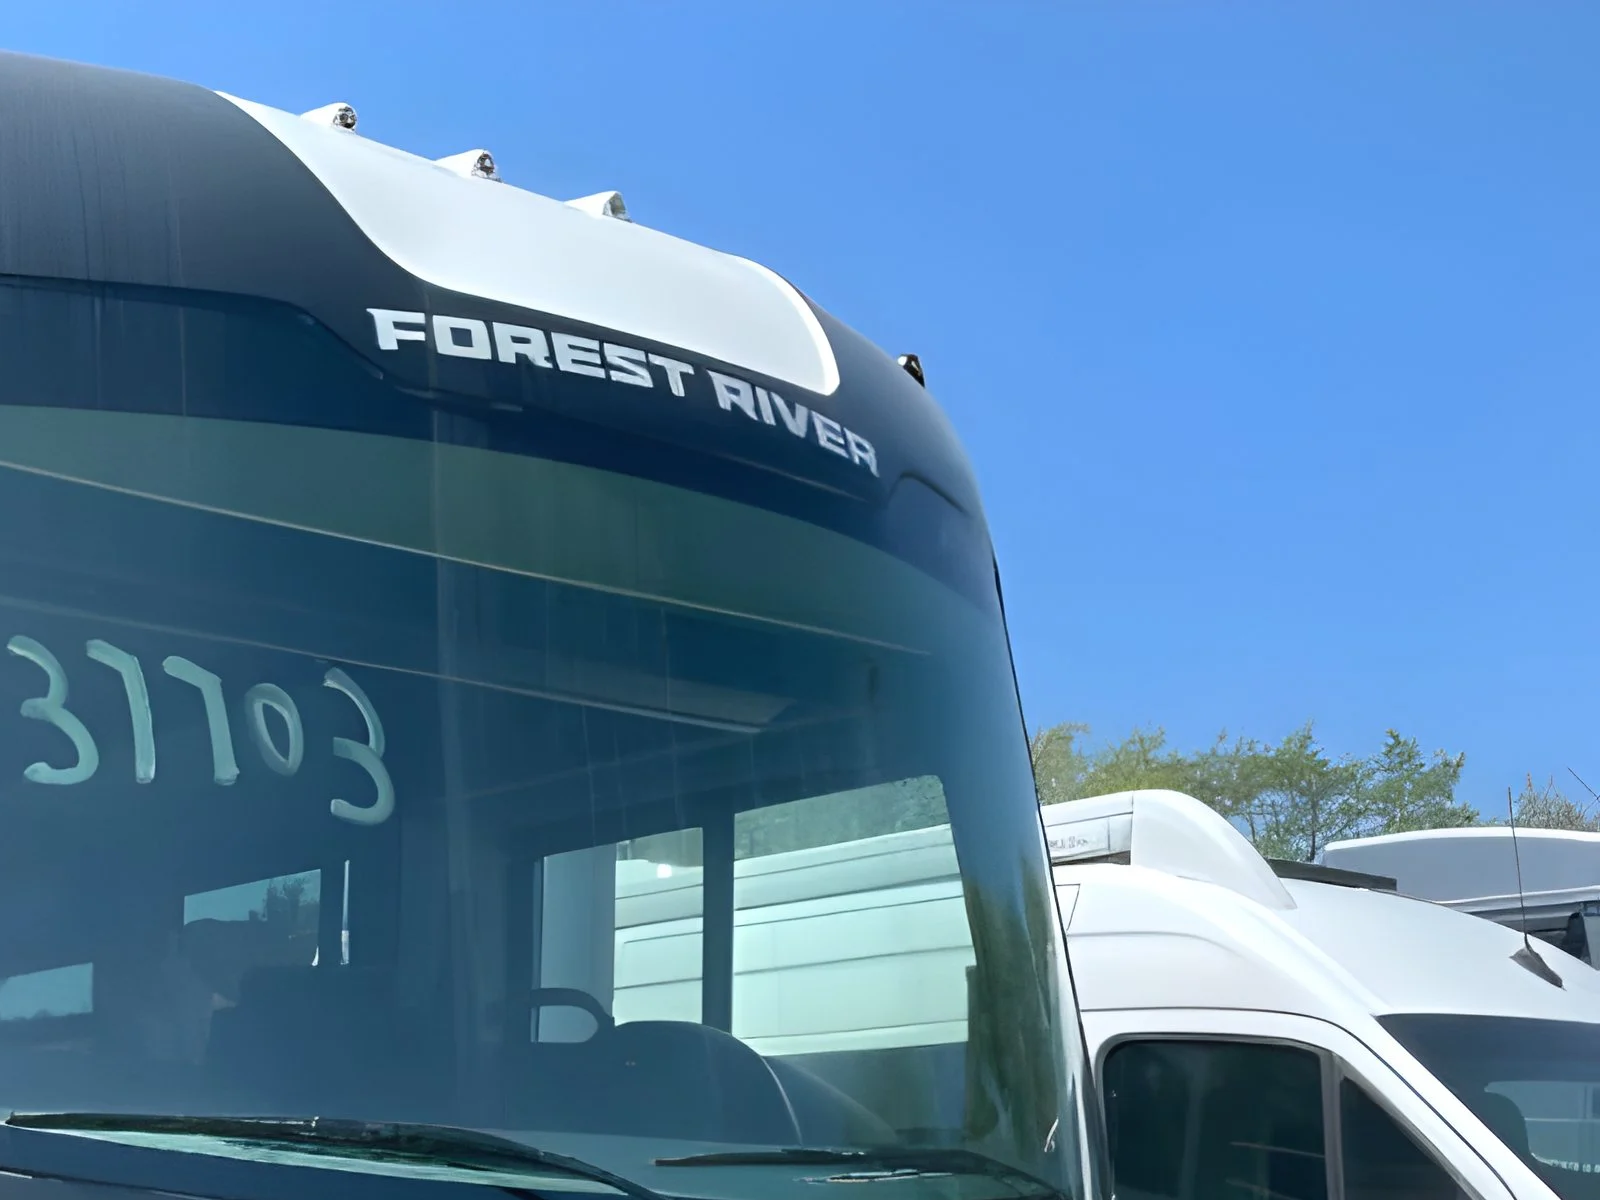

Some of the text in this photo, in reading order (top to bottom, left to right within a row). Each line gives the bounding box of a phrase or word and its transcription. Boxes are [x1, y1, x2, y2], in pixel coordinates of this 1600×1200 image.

[366, 307, 880, 478] FOREST RIVER
[6, 634, 396, 826] 37703
